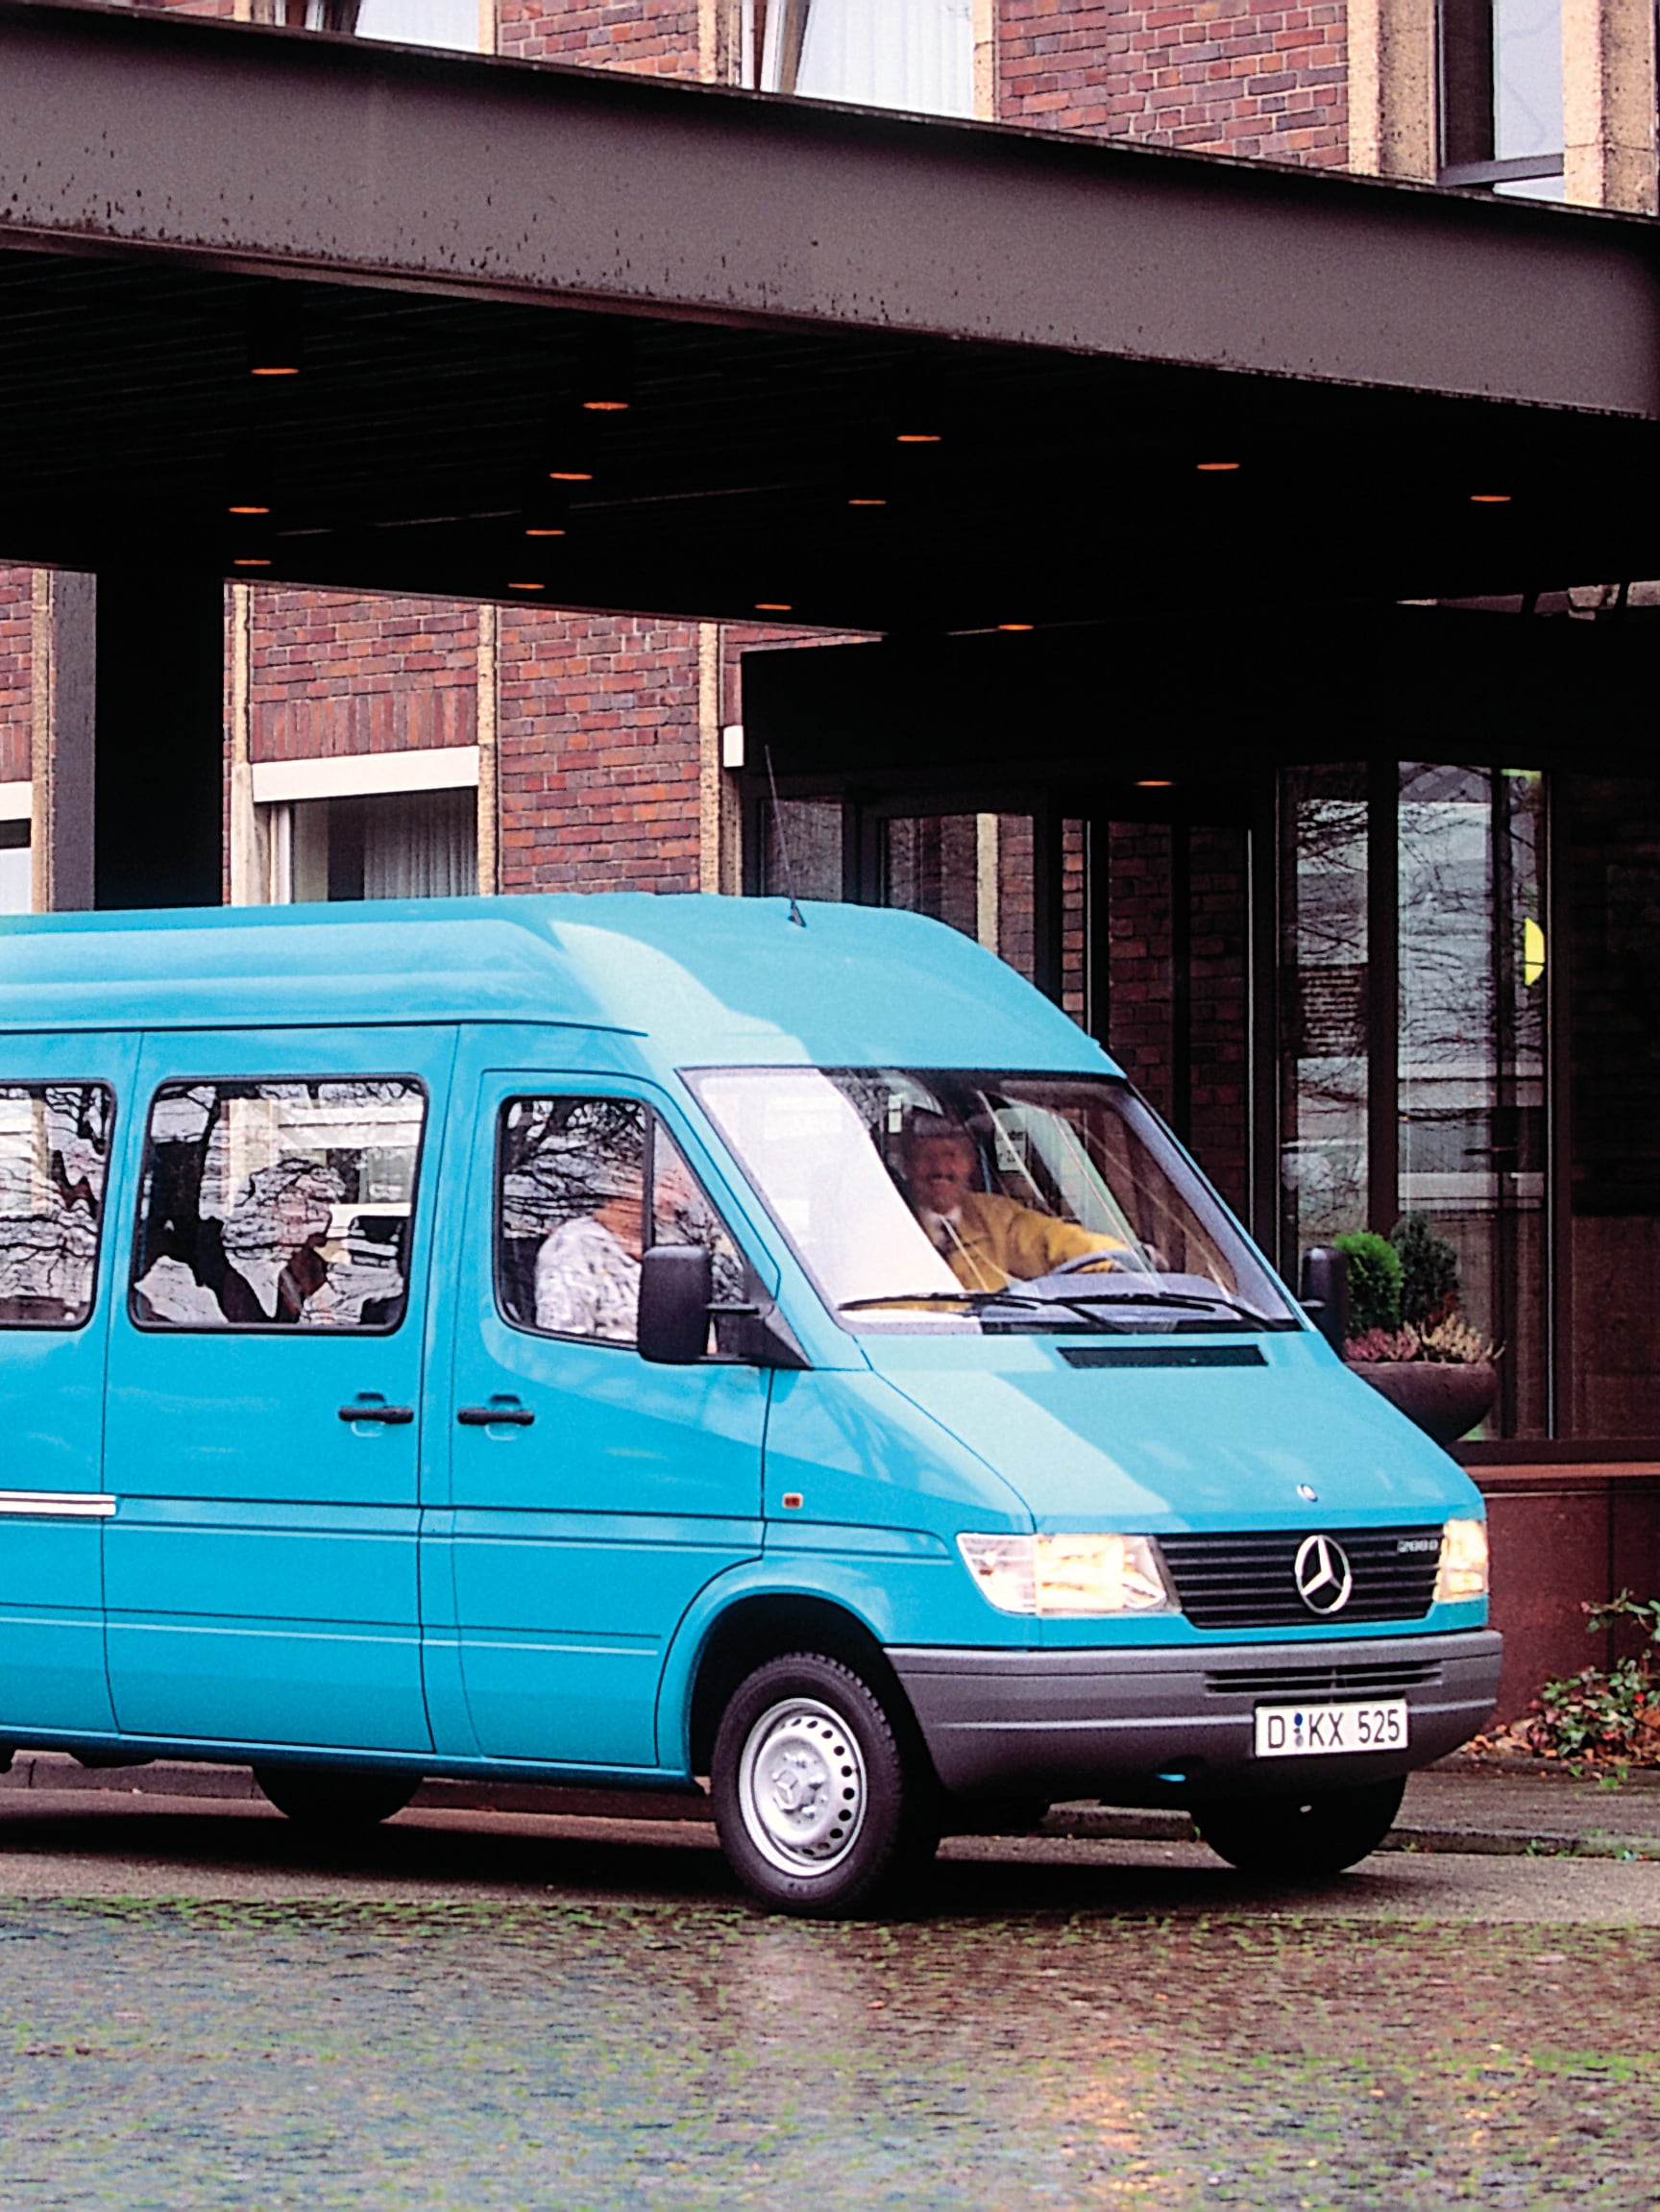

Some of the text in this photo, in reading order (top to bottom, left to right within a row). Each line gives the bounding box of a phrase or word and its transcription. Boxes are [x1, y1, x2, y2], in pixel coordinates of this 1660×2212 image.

[1267, 1708, 1401, 1749] D KX 525
